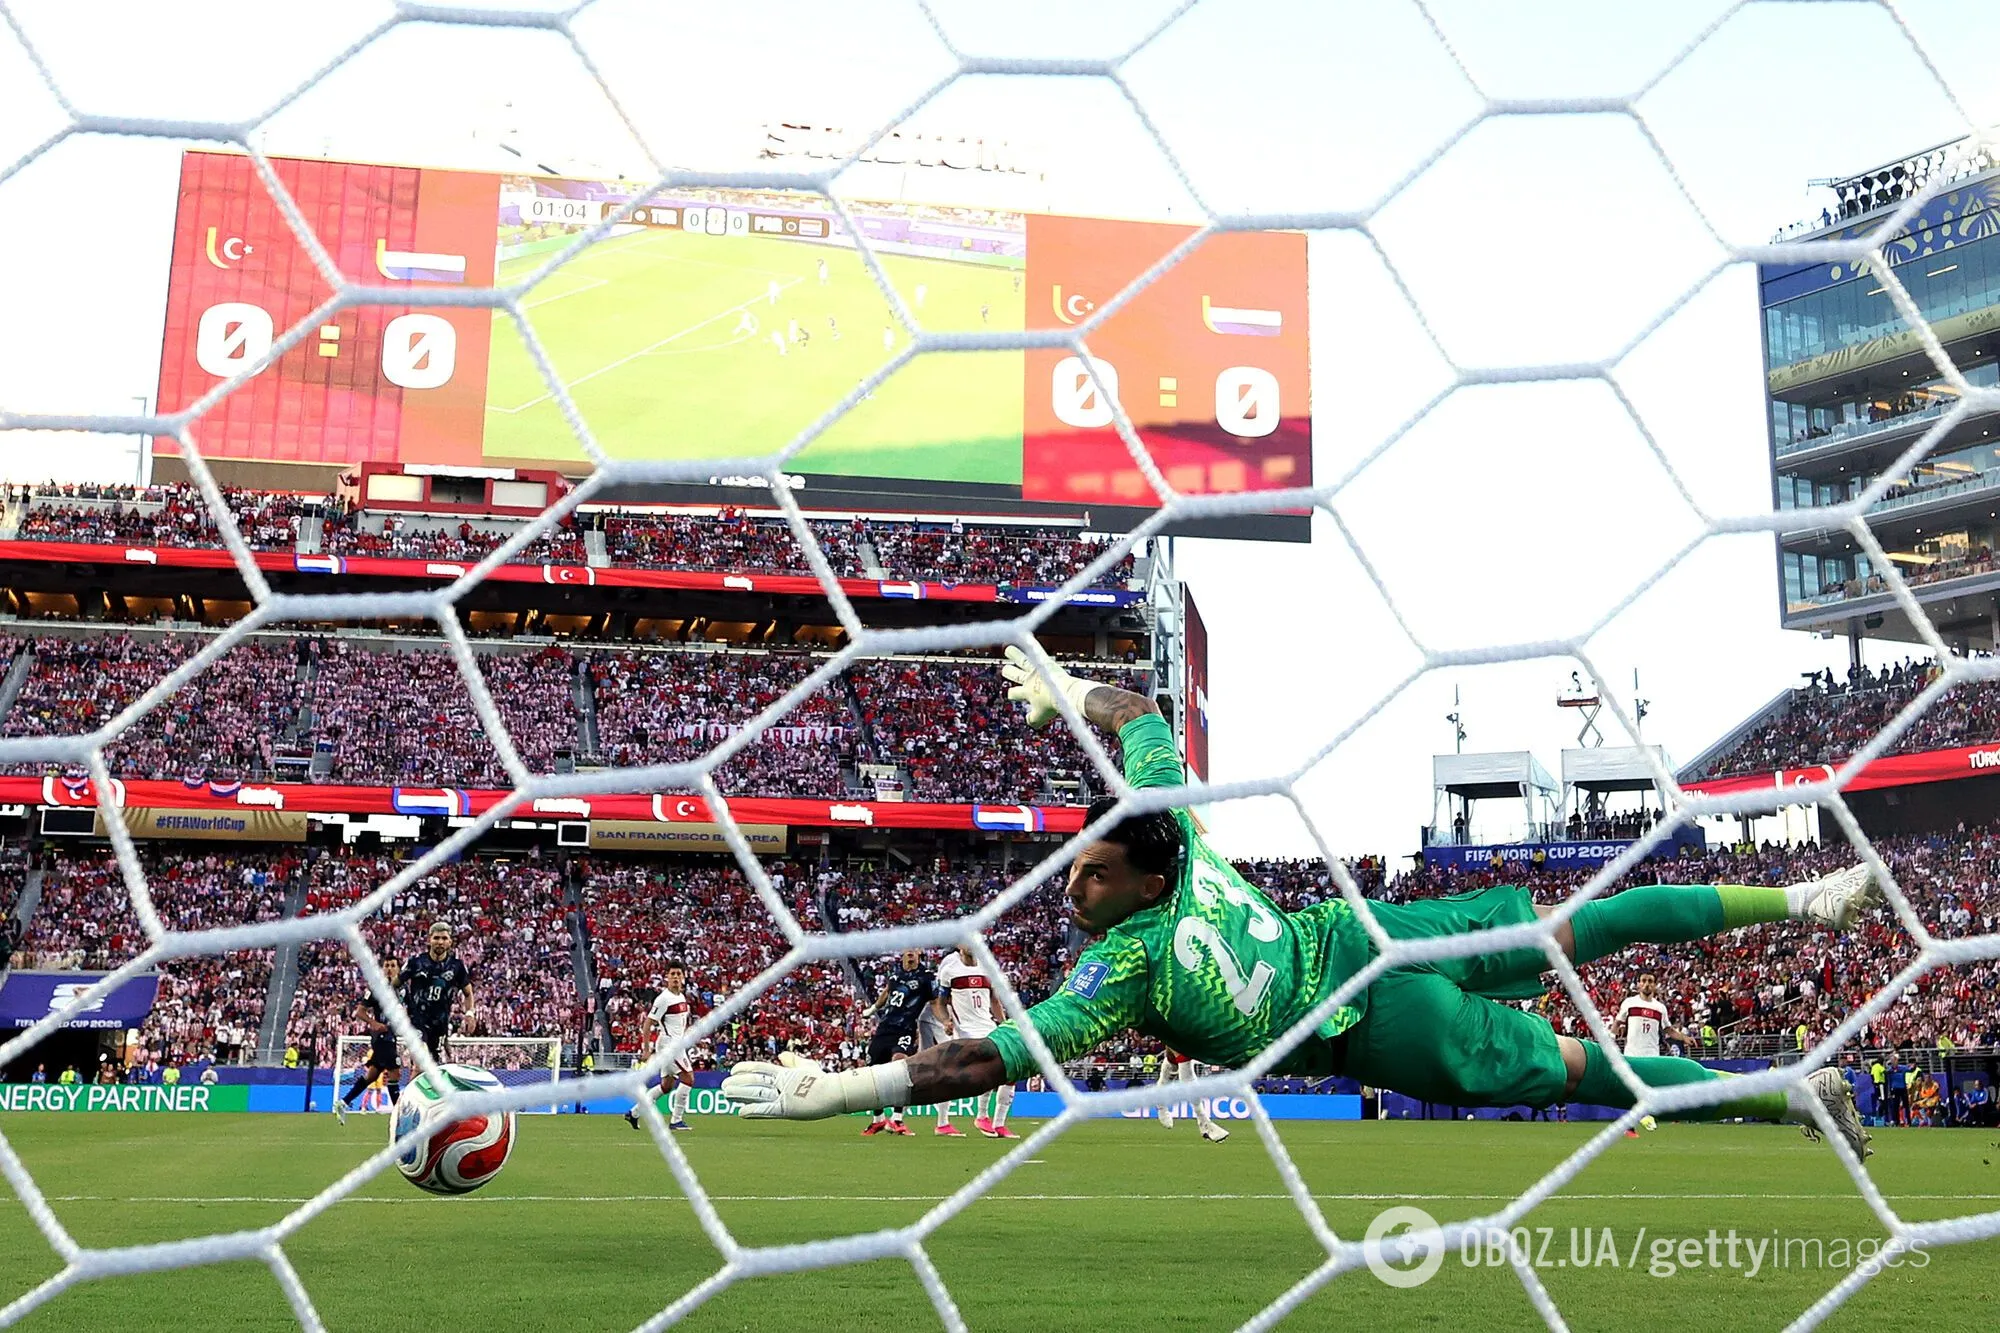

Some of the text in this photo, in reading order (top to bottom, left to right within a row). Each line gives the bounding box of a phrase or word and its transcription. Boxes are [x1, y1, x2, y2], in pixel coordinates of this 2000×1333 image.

[532, 200, 588, 220] 01:04
[690, 213, 699, 227] 0
[733, 216, 743, 230] 0
[196, 302, 275, 378] 0
[382, 314, 457, 389] 0
[1052, 357, 1119, 428] 0
[1216, 366, 1281, 438] 0
[156, 816, 245, 831] #FIFAWorldCup
[596, 831, 626, 840] SAN
[629, 832, 709, 842] FRANCISCO
[1465, 850, 1493, 862] FIFA
[1549, 848, 1577, 859] CUP
[1174, 859, 1283, 1017] 23
[427, 985, 442, 1001] 19
[890, 990, 905, 1007] 23
[70, 1020, 90, 1028] CUP
[88, 1085, 209, 1111] PARTNER
